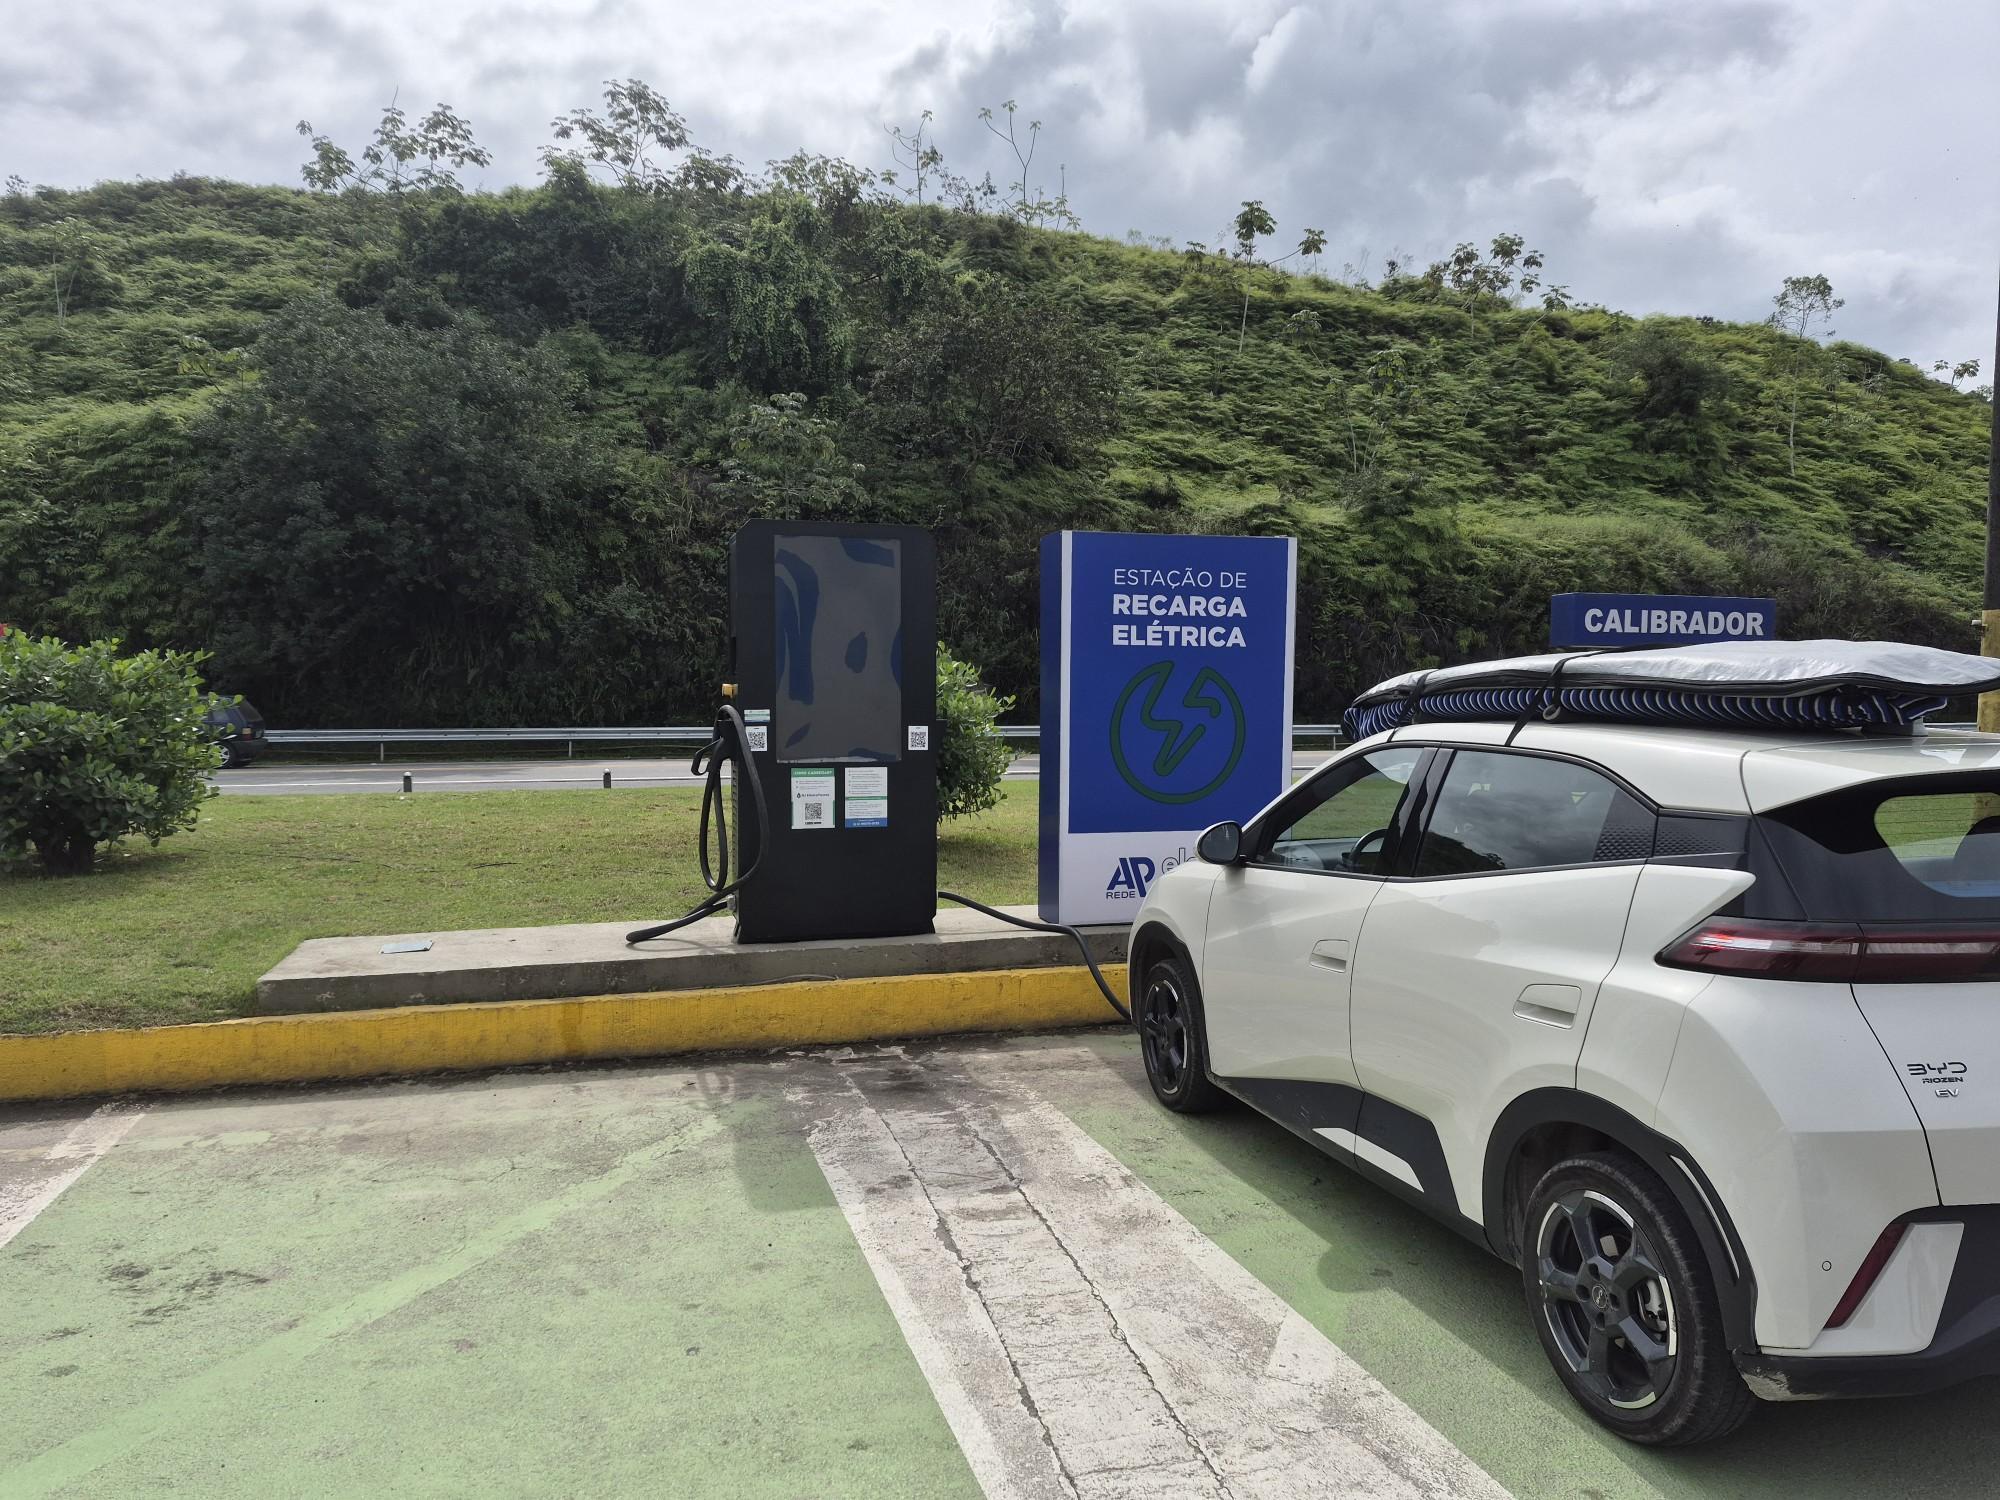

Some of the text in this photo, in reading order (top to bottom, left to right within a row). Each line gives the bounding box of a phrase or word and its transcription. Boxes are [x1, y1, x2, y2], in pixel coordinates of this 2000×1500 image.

[1114, 567, 1247, 589] ESTAÇÃO DE
[1112, 593, 1248, 617] RECARGA
[1112, 619, 1247, 647] ELÉTRICA
[1584, 608, 1764, 636] CALIBRADOR
[1106, 856, 1156, 898] AP
[1105, 890, 1136, 899] REDE
[1906, 1062, 1968, 1076] BYD
[1935, 1088, 1960, 1098] EV
